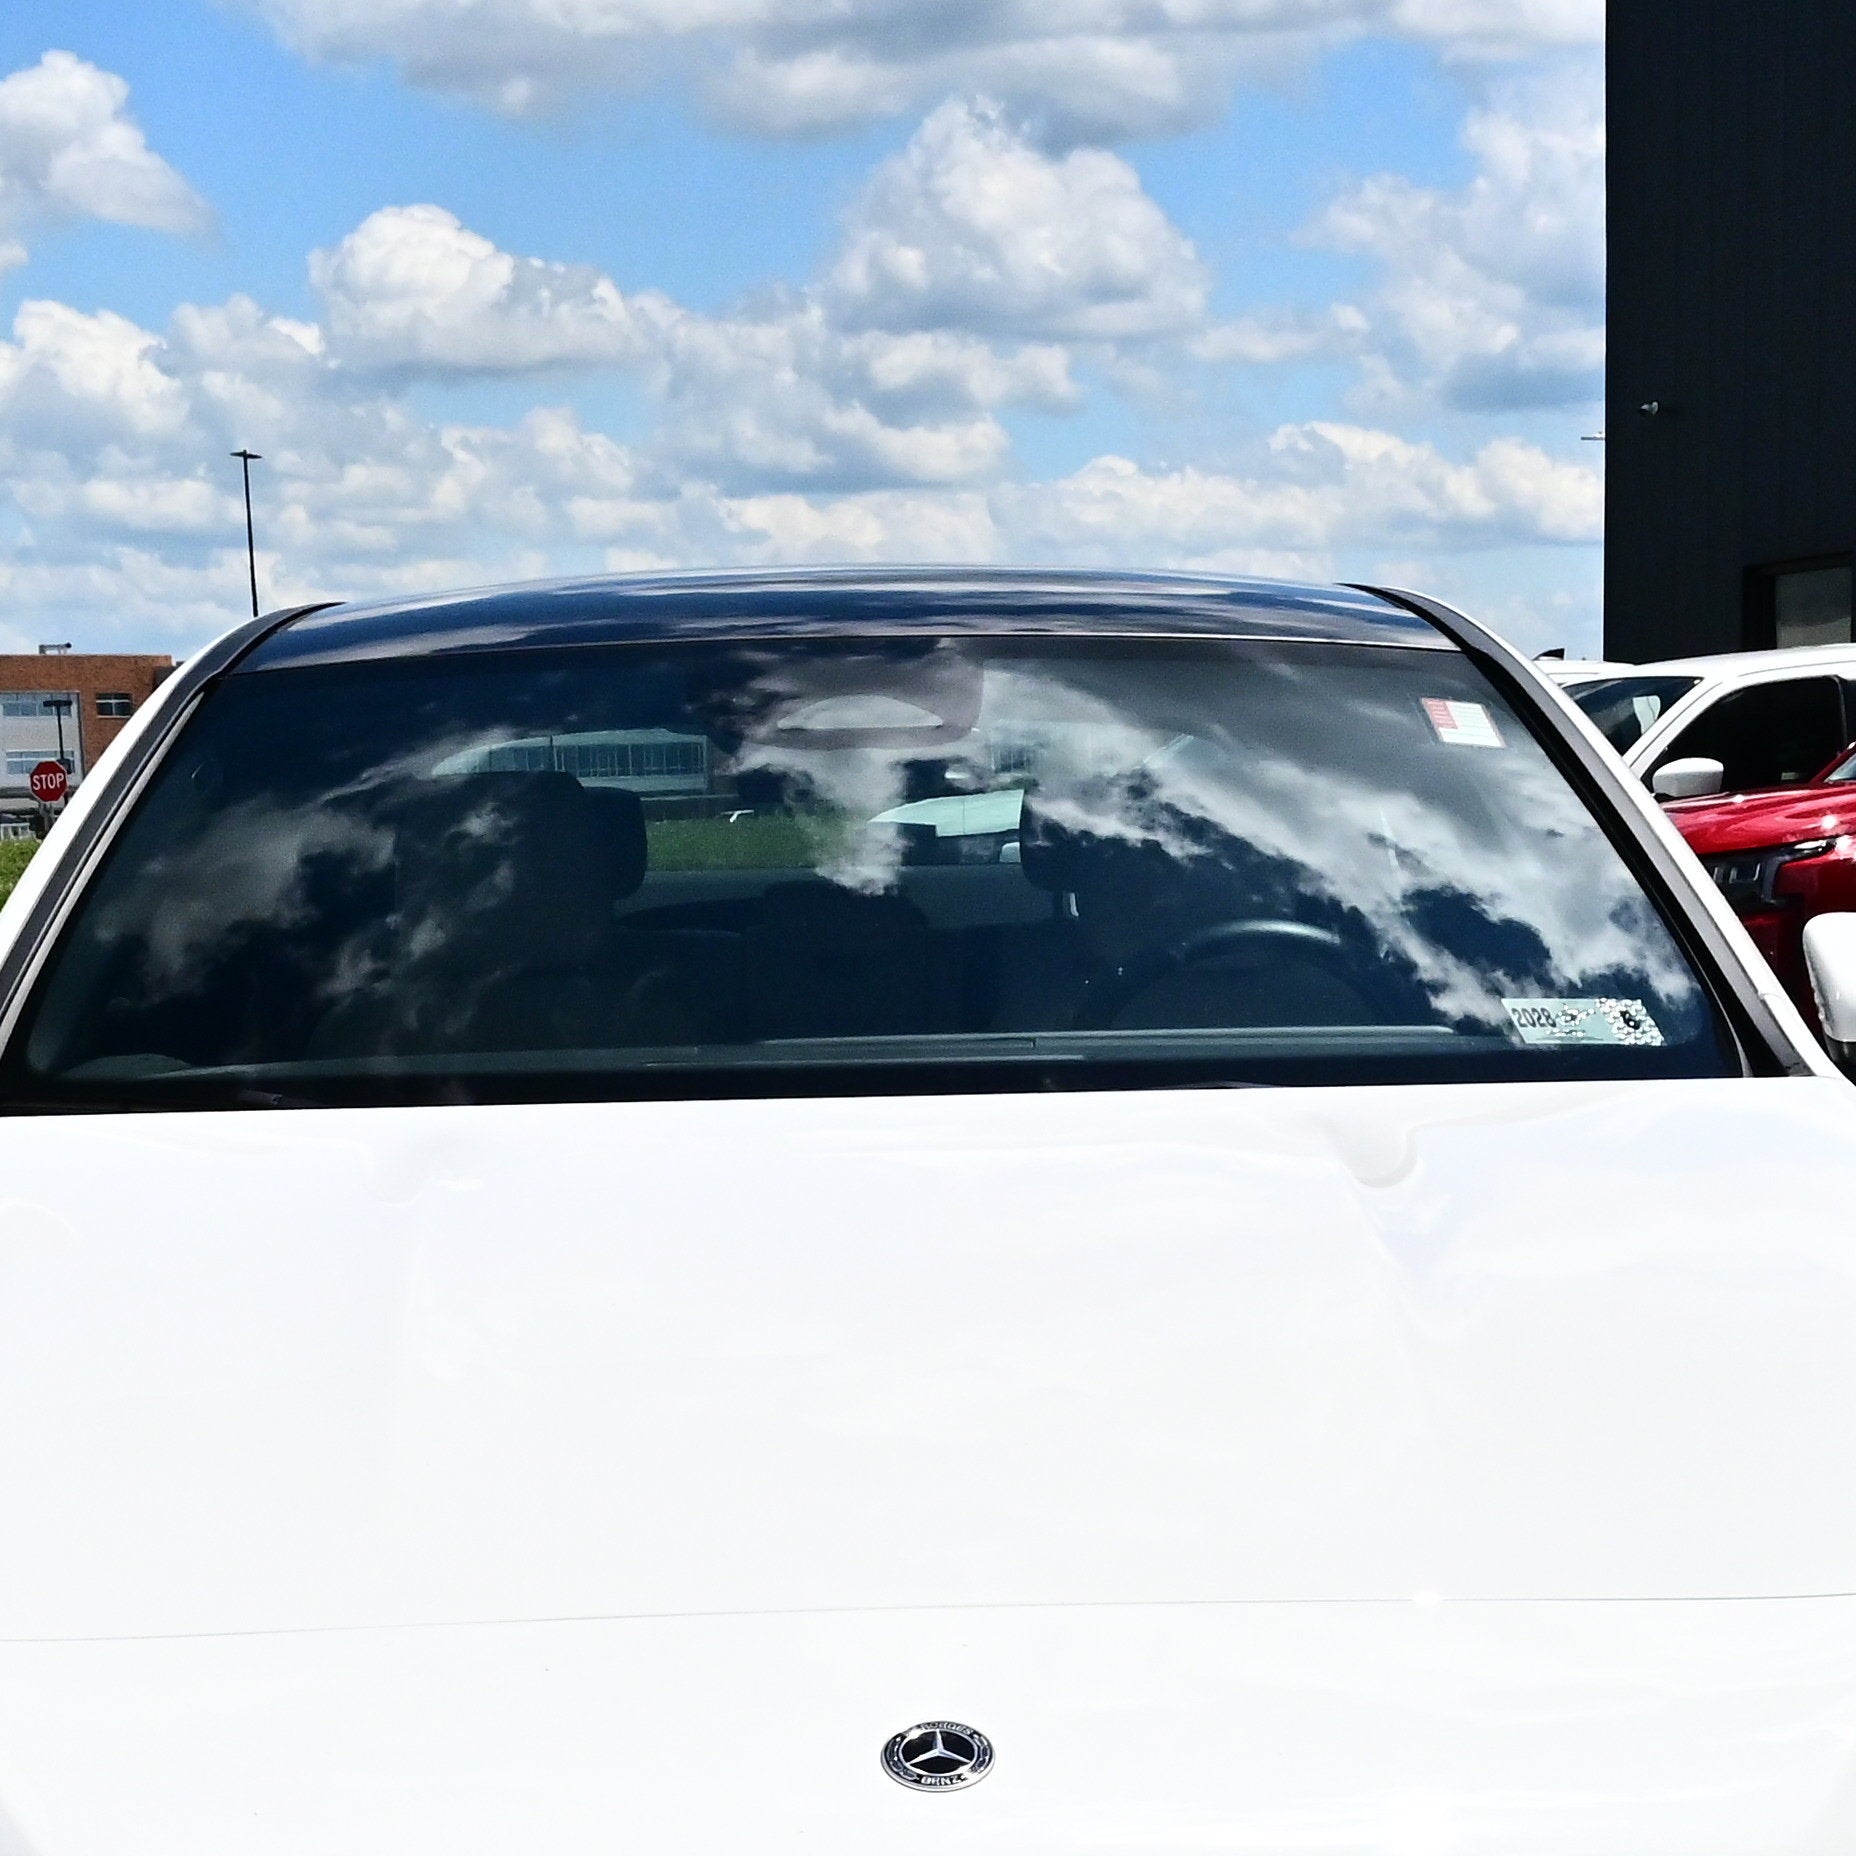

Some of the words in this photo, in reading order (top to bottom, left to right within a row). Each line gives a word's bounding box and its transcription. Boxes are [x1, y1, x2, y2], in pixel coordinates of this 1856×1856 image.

[33, 773, 64, 790] STOP
[1511, 1008, 1556, 1028] 2028
[920, 1775, 961, 1787] BENZ
